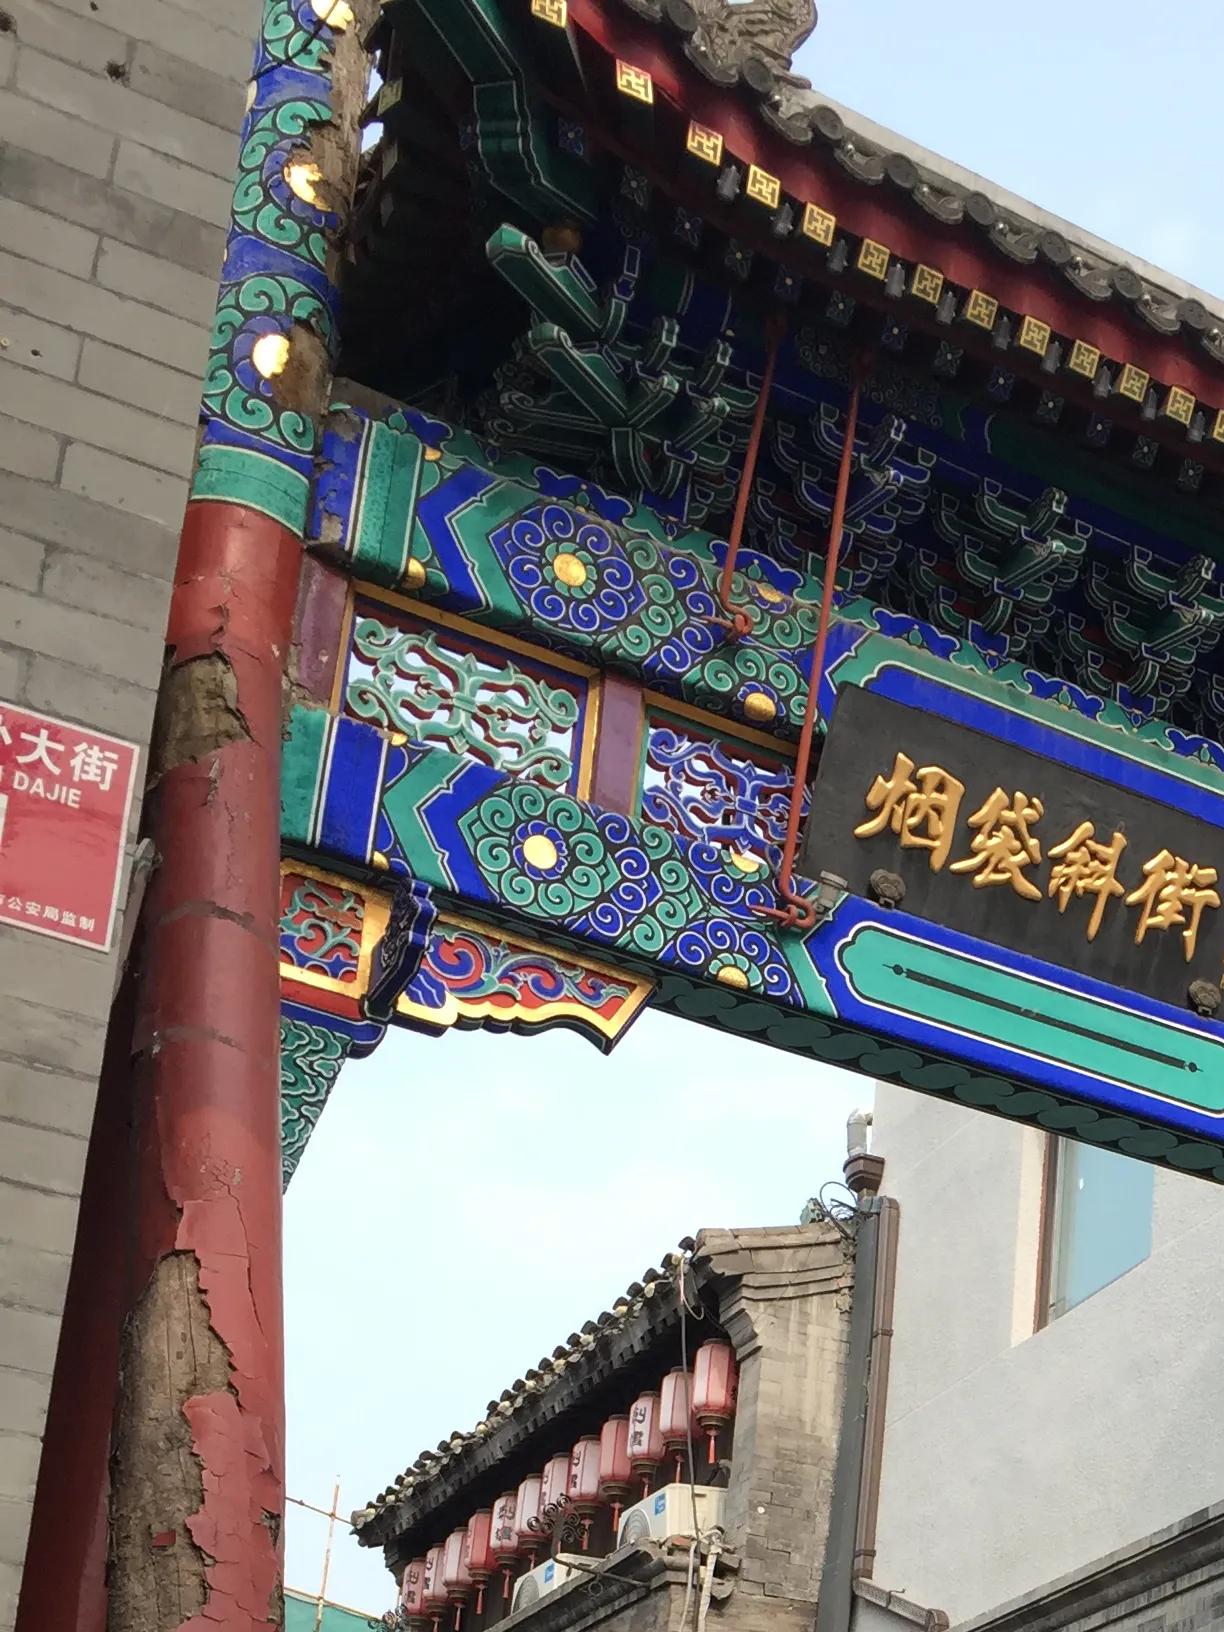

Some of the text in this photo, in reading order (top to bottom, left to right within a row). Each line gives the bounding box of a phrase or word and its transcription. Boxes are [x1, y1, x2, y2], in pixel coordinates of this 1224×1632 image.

[12, 769, 82, 809] DAJIE
[854, 752, 1221, 962] 烟袋斜街
